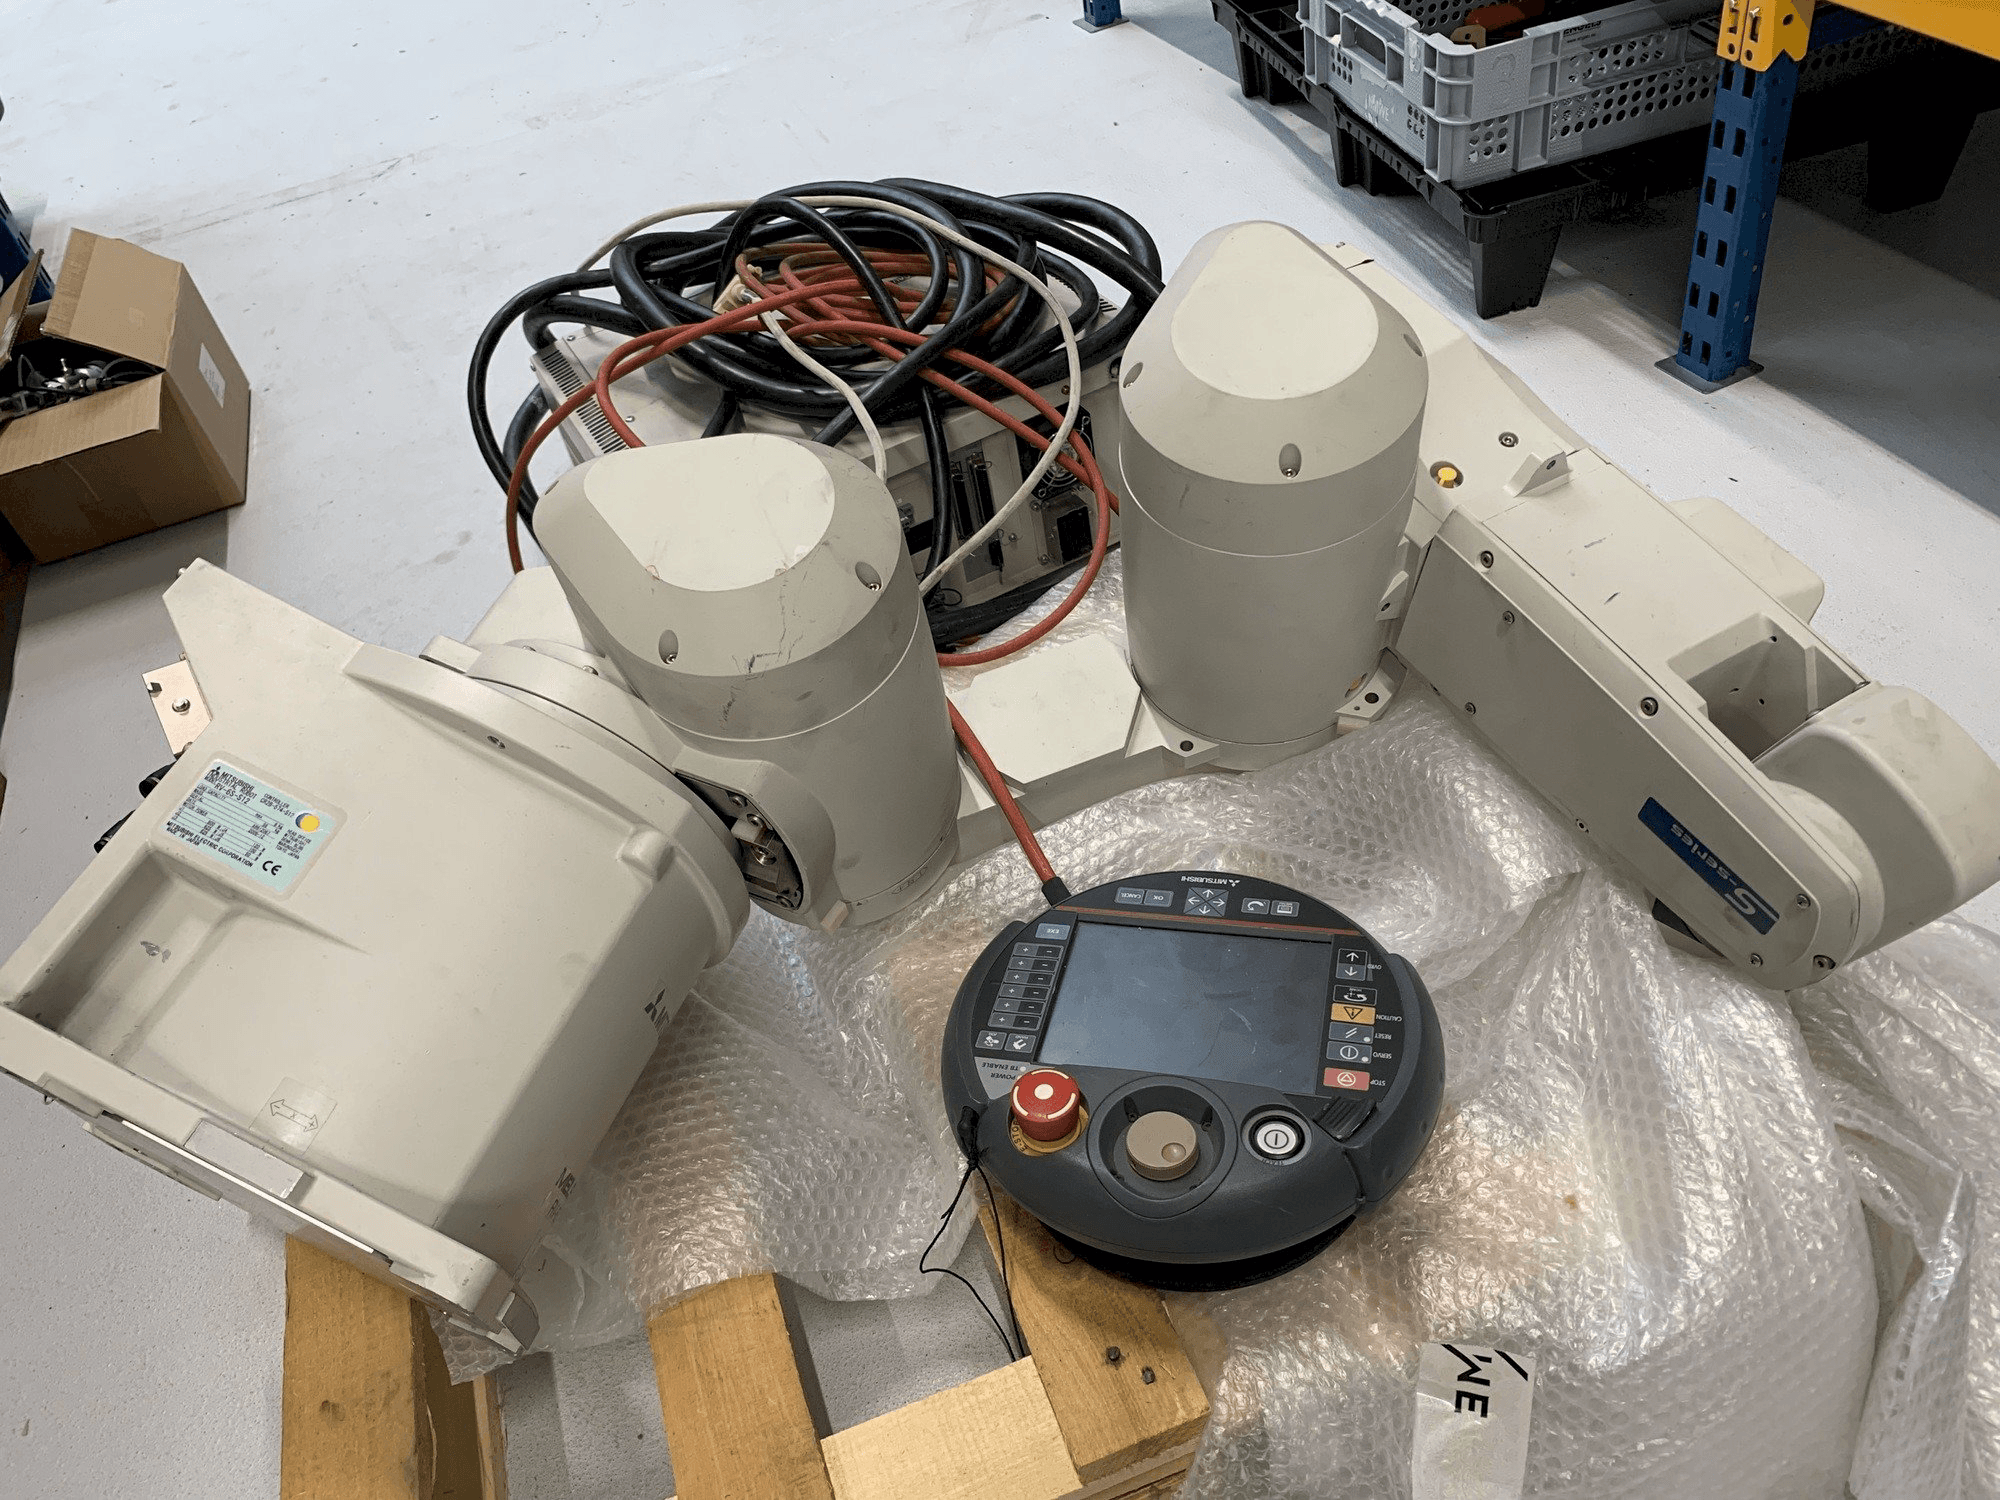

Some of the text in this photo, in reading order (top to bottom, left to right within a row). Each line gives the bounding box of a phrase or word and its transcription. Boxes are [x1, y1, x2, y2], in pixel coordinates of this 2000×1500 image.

[214, 783, 251, 804] RV-6S-S12
[194, 834, 218, 850] ELECTRIC
[218, 847, 254, 867] CORPORATION
[262, 860, 282, 876] CE
[1181, 876, 1228, 885] MITSUBISHI
[1376, 1014, 1402, 1022] CAUTION
[1374, 1032, 1392, 1040] RESET
[1373, 1051, 1392, 1059] SERVO
[982, 1062, 1009, 1070] ENABLE
[990, 1072, 1016, 1080] POWER
[1370, 1079, 1386, 1087] STOP
